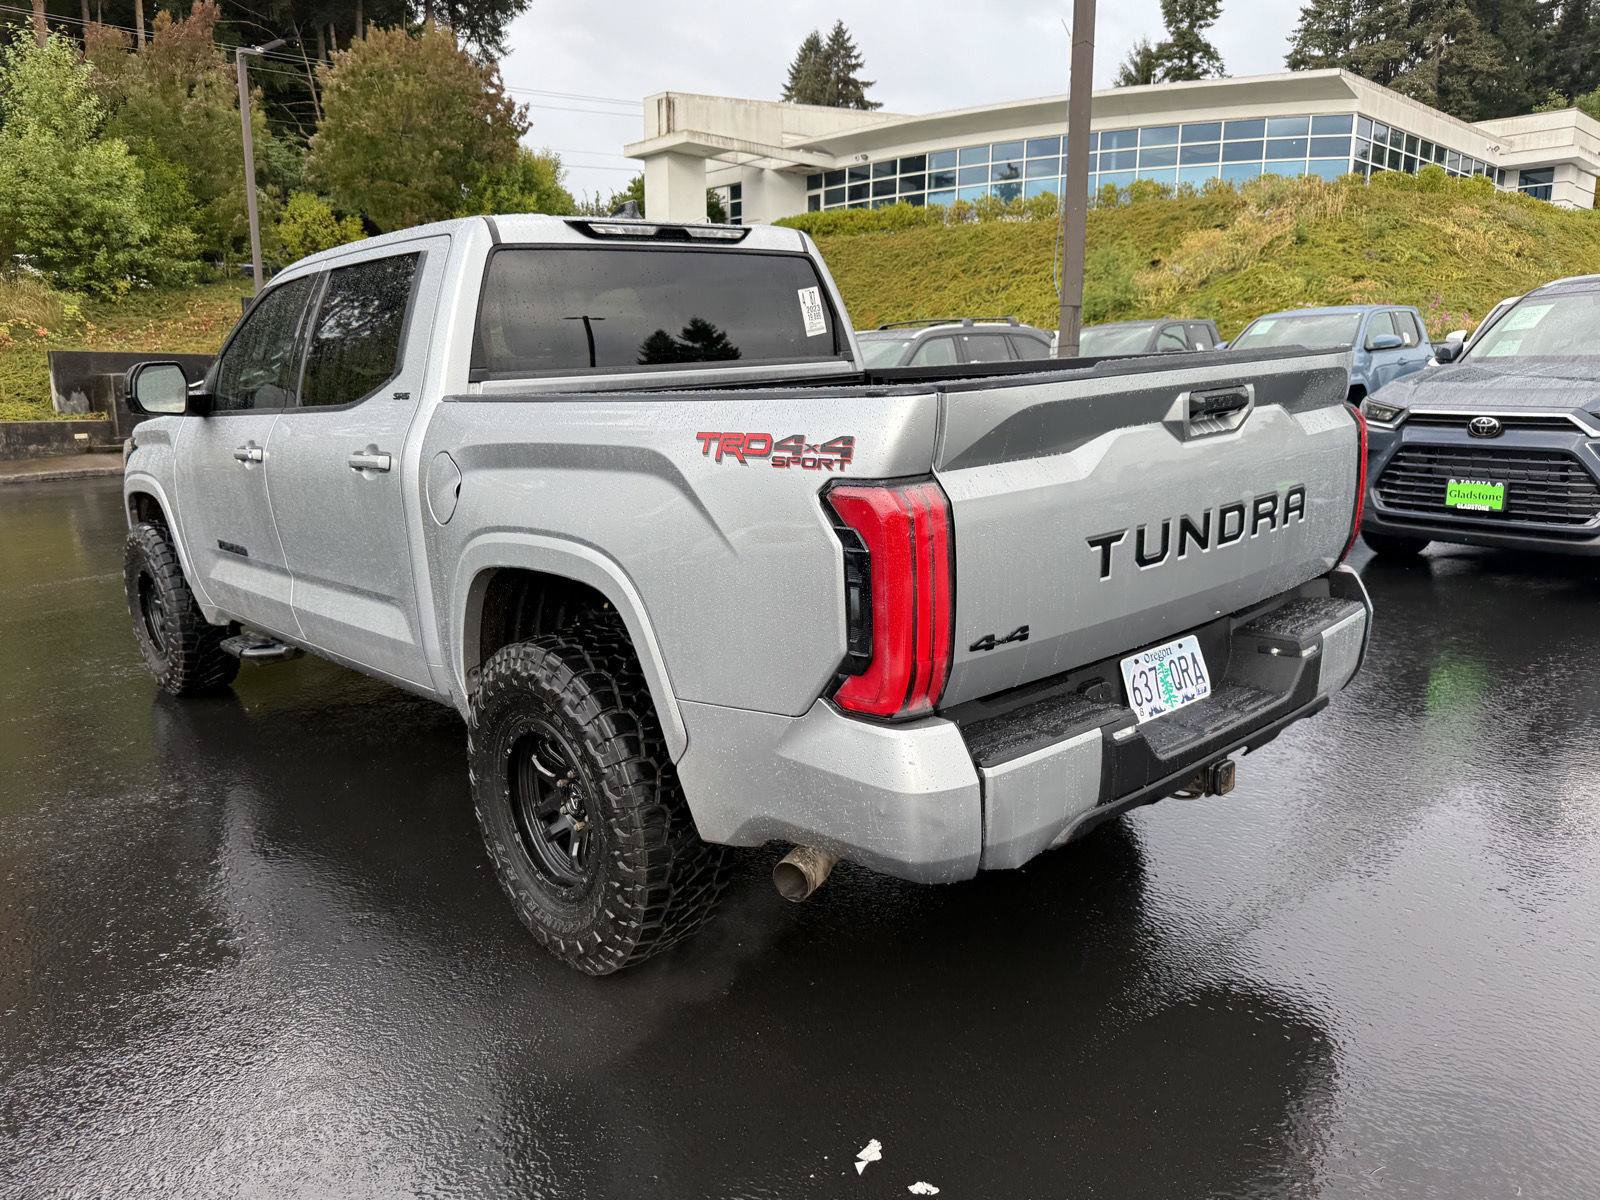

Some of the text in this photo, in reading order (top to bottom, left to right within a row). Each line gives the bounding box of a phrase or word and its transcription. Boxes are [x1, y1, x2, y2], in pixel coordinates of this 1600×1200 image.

[696, 432, 774, 467] TRD
[771, 456, 851, 472] SPORT
[1449, 490, 1502, 502] Gladstone
[1085, 483, 1306, 582] TUNDRA
[1144, 647, 1173, 663] Oregon
[1132, 652, 1206, 707] 637 QRA
